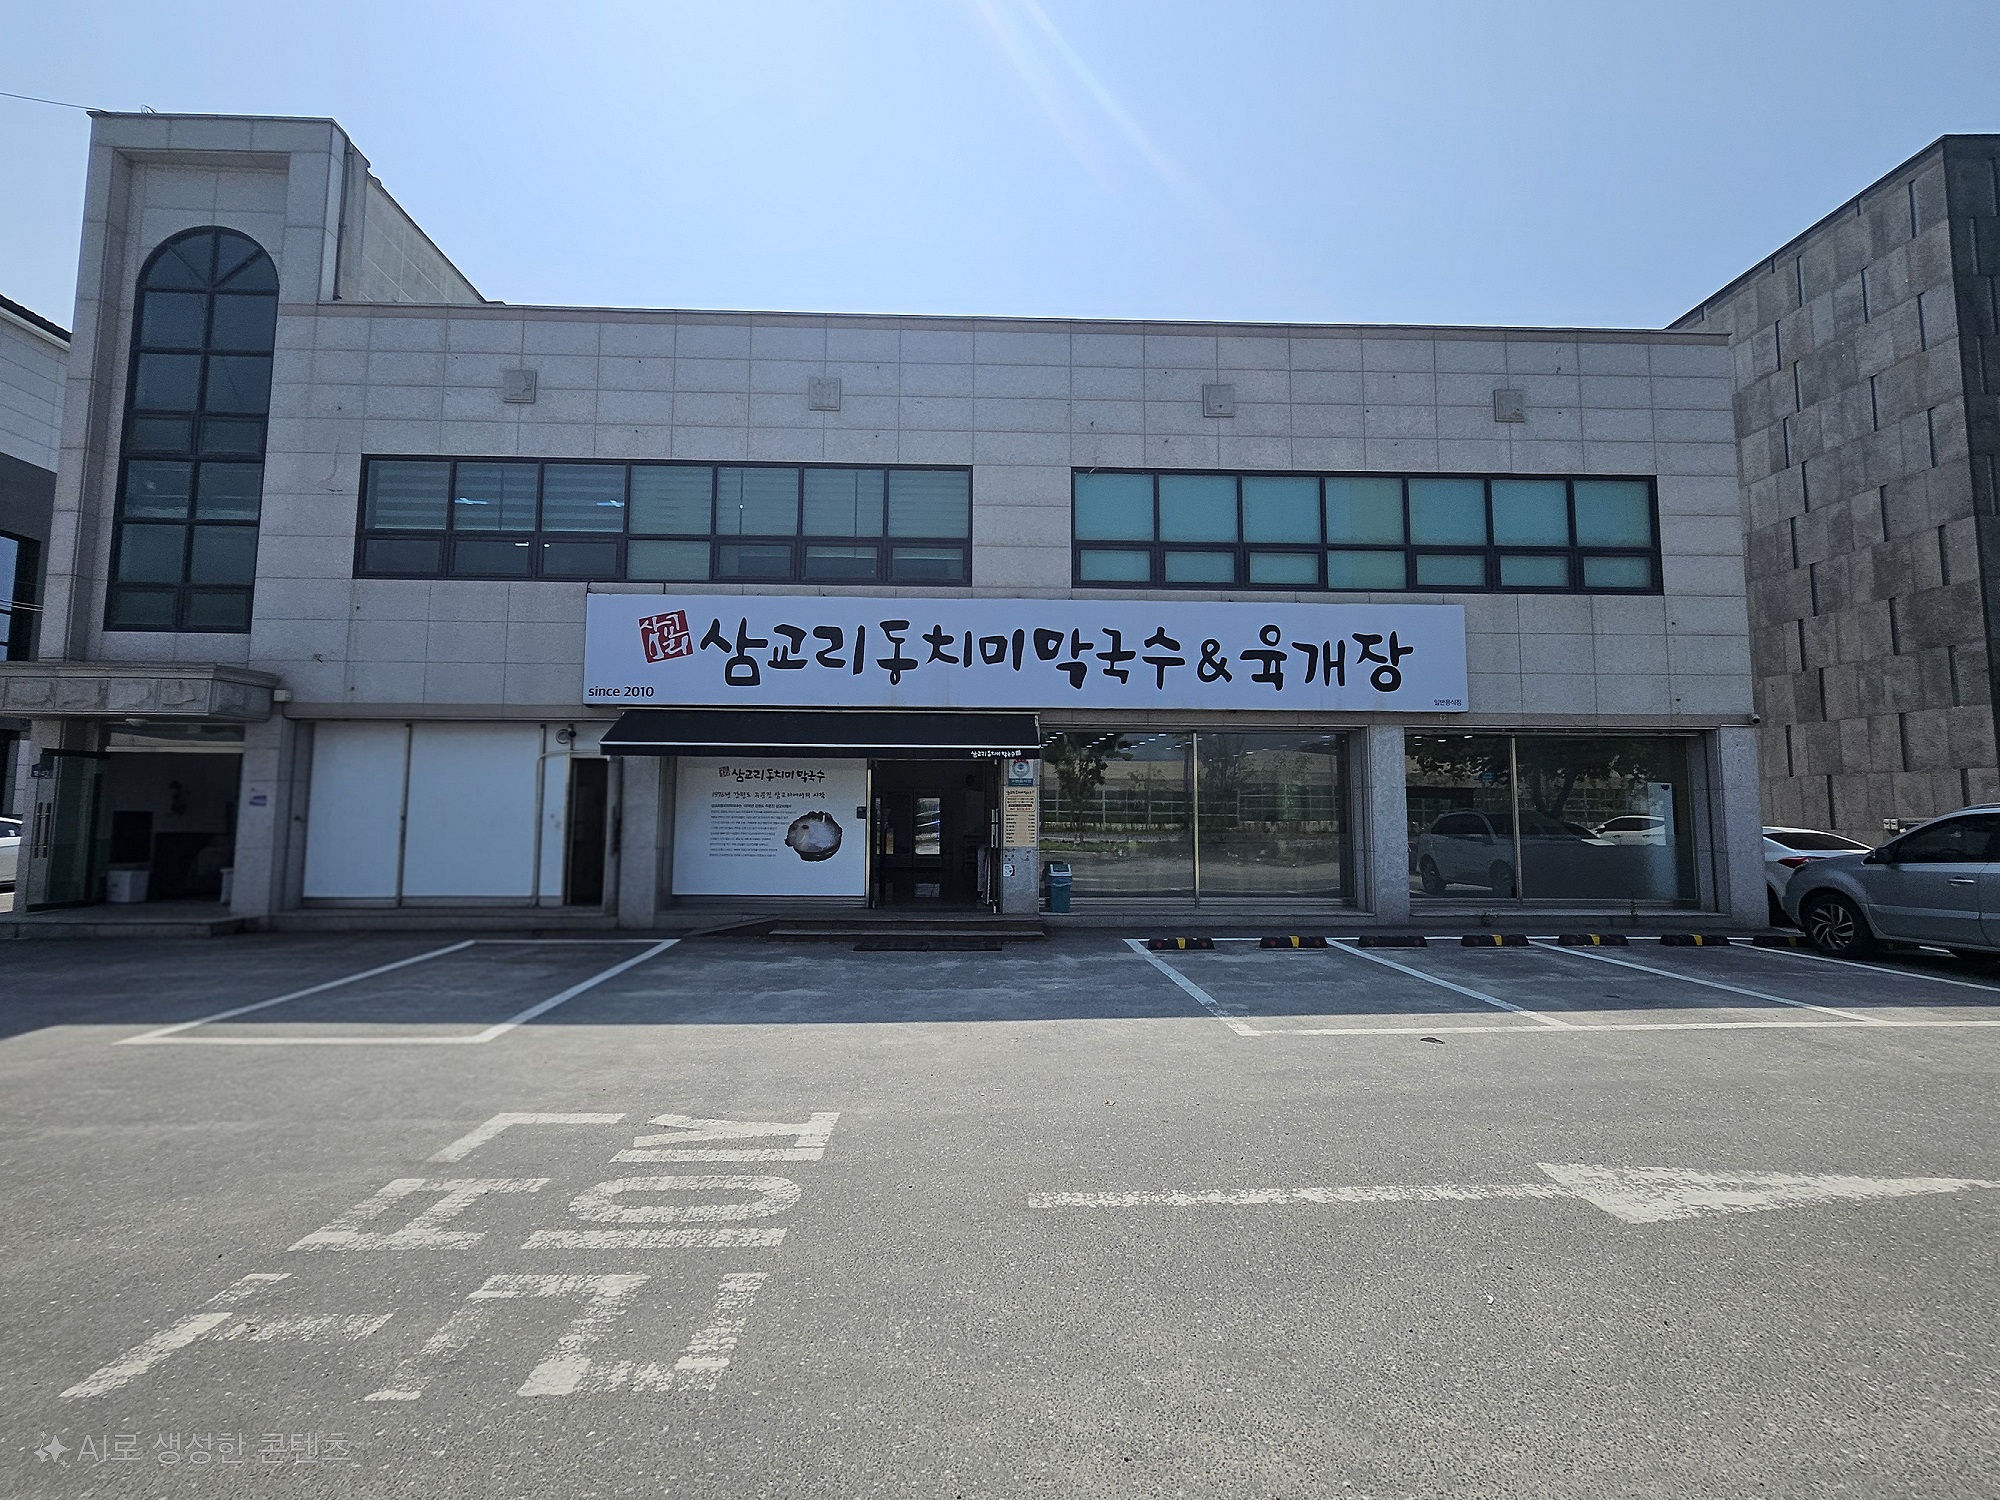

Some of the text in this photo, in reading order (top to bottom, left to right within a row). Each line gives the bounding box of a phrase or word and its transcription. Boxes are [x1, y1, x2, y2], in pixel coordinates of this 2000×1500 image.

[588, 685, 654, 697] since 2010
[1433, 699, 1462, 707] 일반음식점
